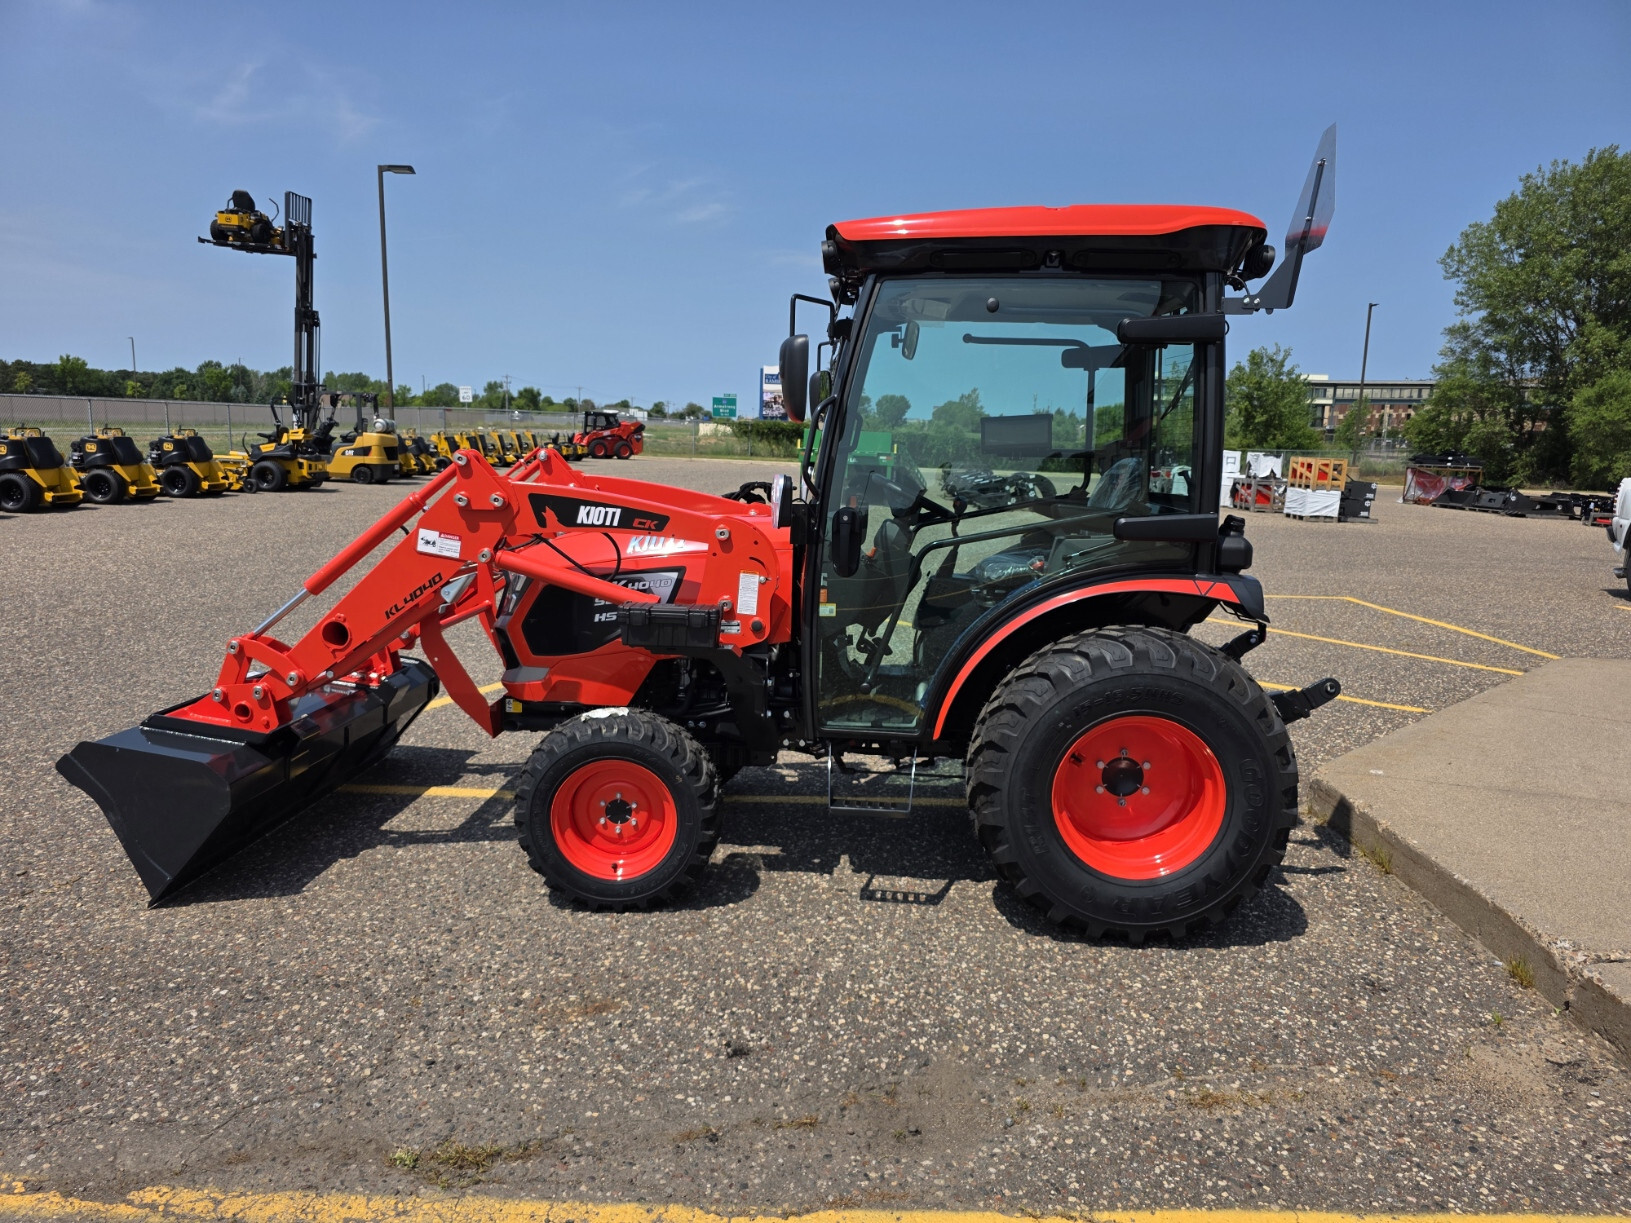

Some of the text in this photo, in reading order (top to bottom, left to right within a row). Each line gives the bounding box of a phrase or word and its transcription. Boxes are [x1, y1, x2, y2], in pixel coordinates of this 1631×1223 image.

[576, 505, 622, 527] KIOTI
[632, 518, 659, 530] CK
[384, 572, 443, 620] KL4040
